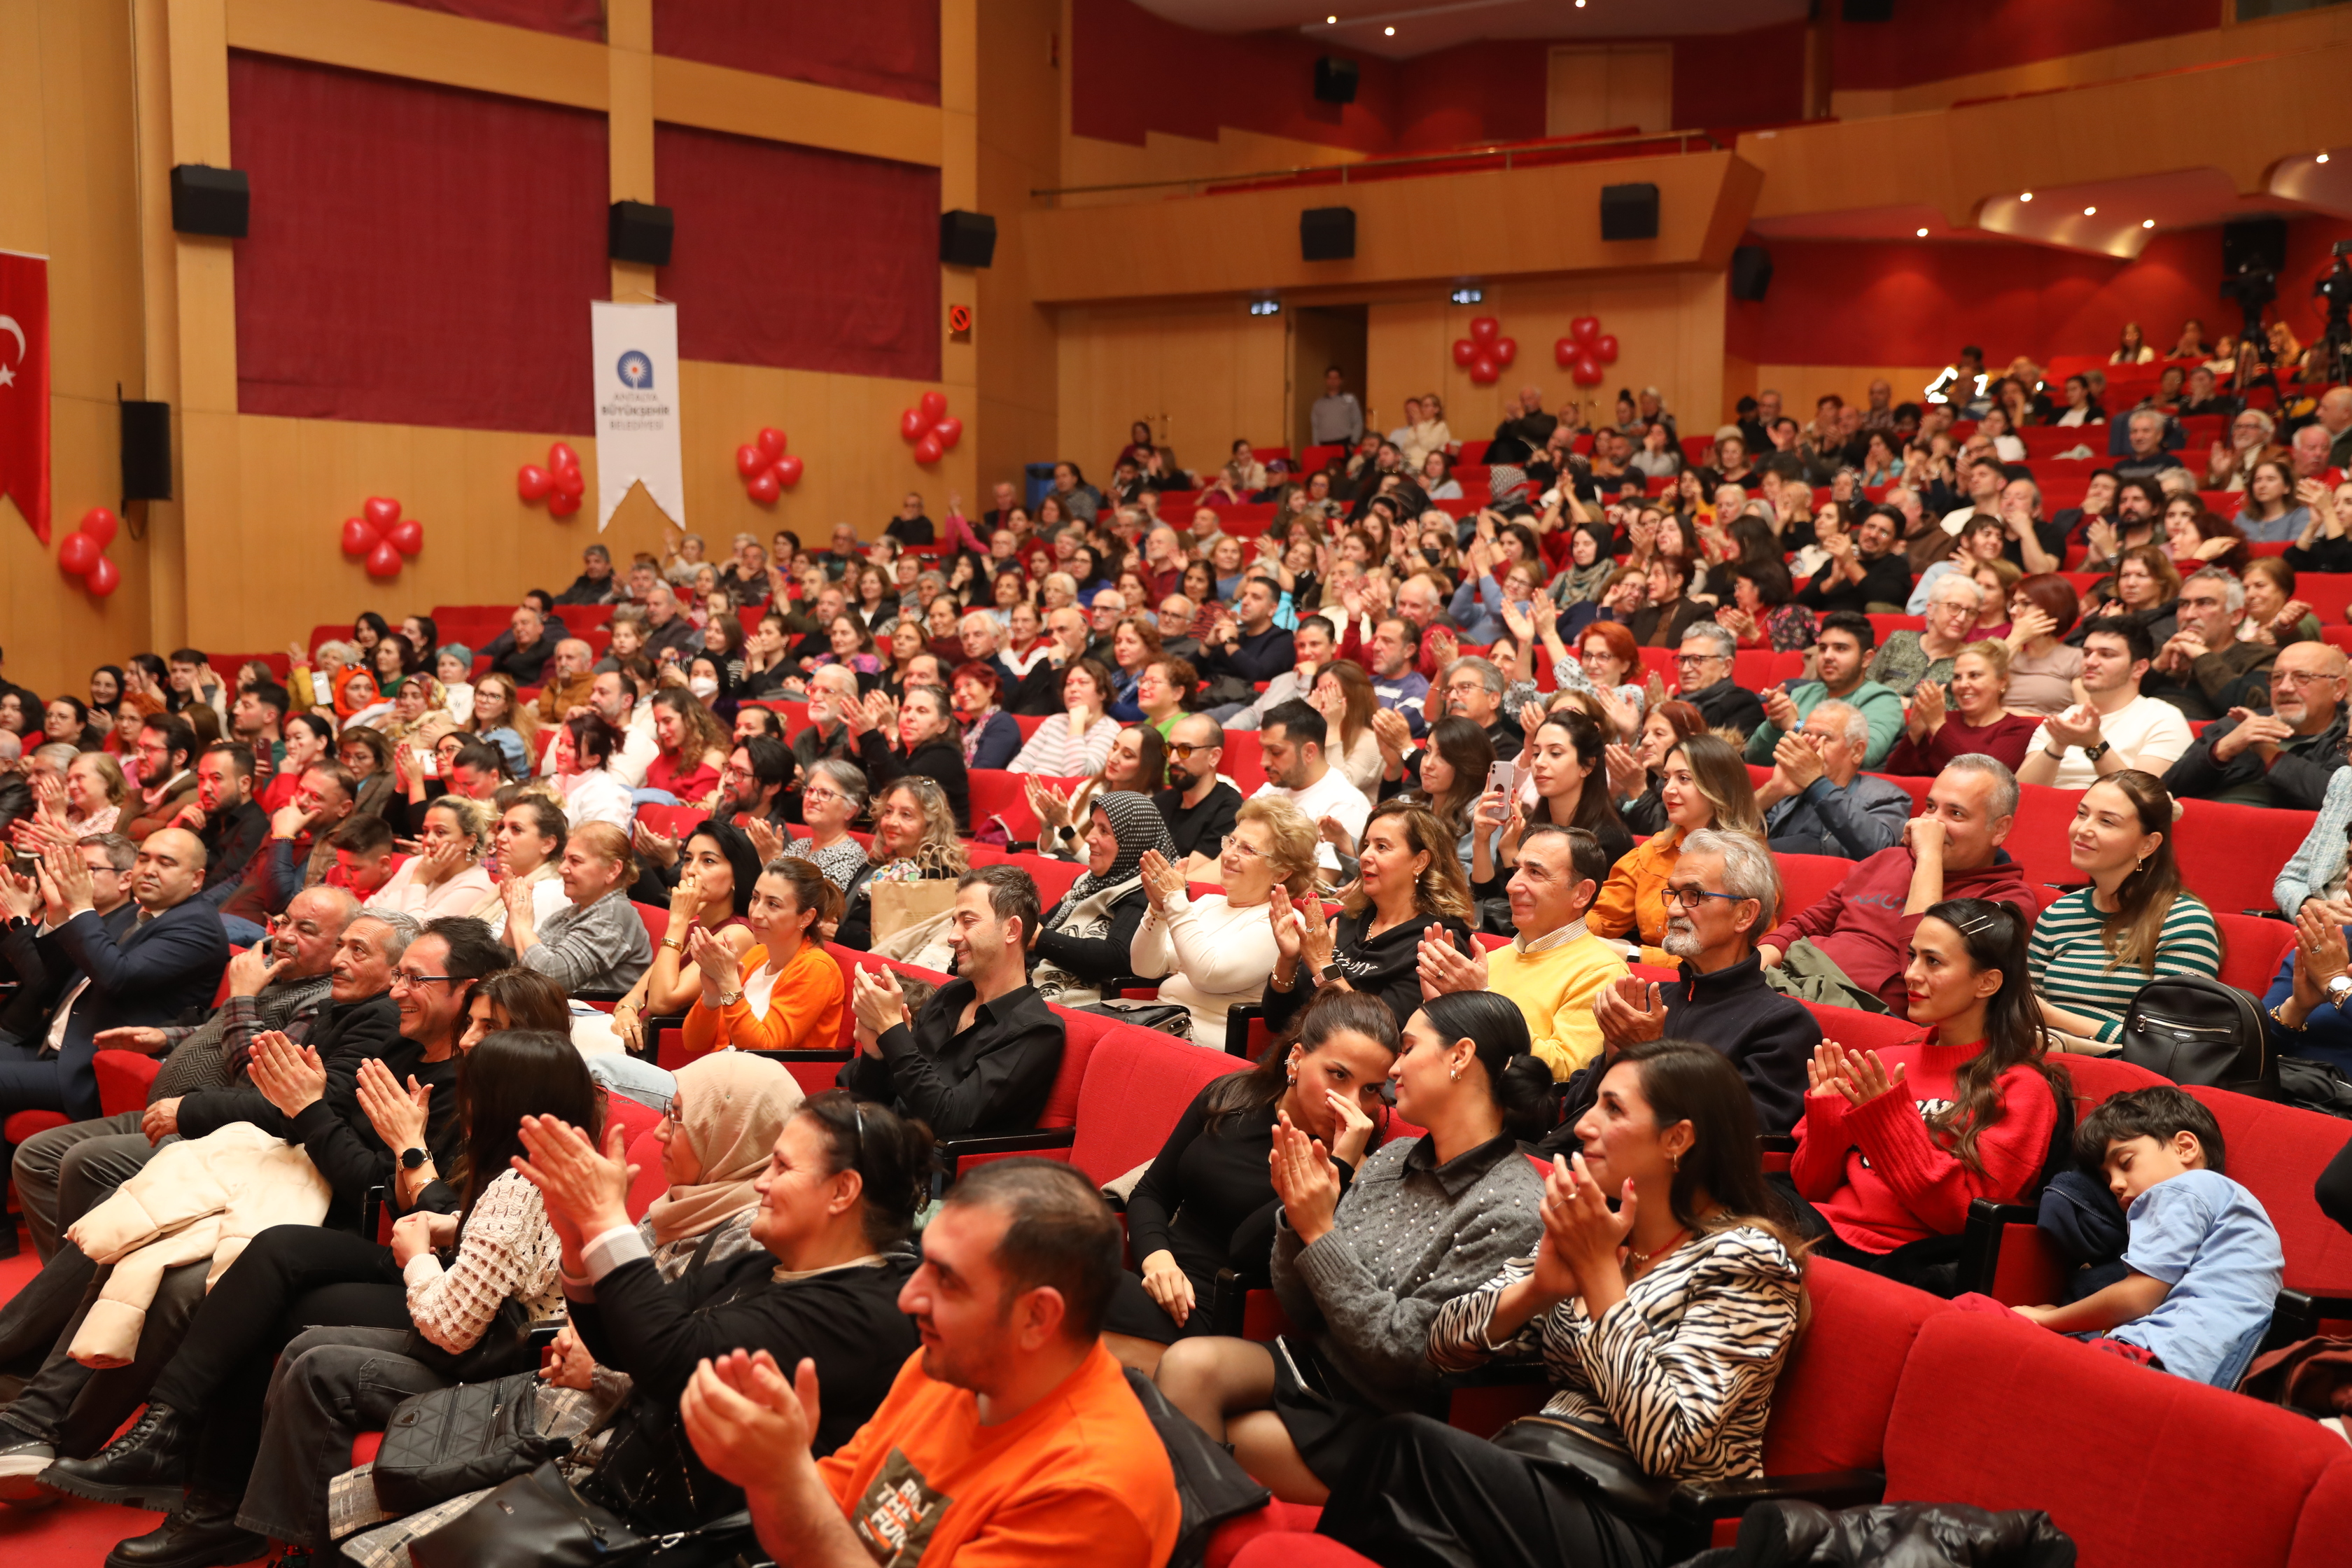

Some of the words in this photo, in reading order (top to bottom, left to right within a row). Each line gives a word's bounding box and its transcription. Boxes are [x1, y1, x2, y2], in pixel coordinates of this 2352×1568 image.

[613, 392, 658, 402] ANTALYA
[601, 403, 670, 416] BÜYÜKŞEHİR
[609, 419, 663, 430] BELEDİYESİ
